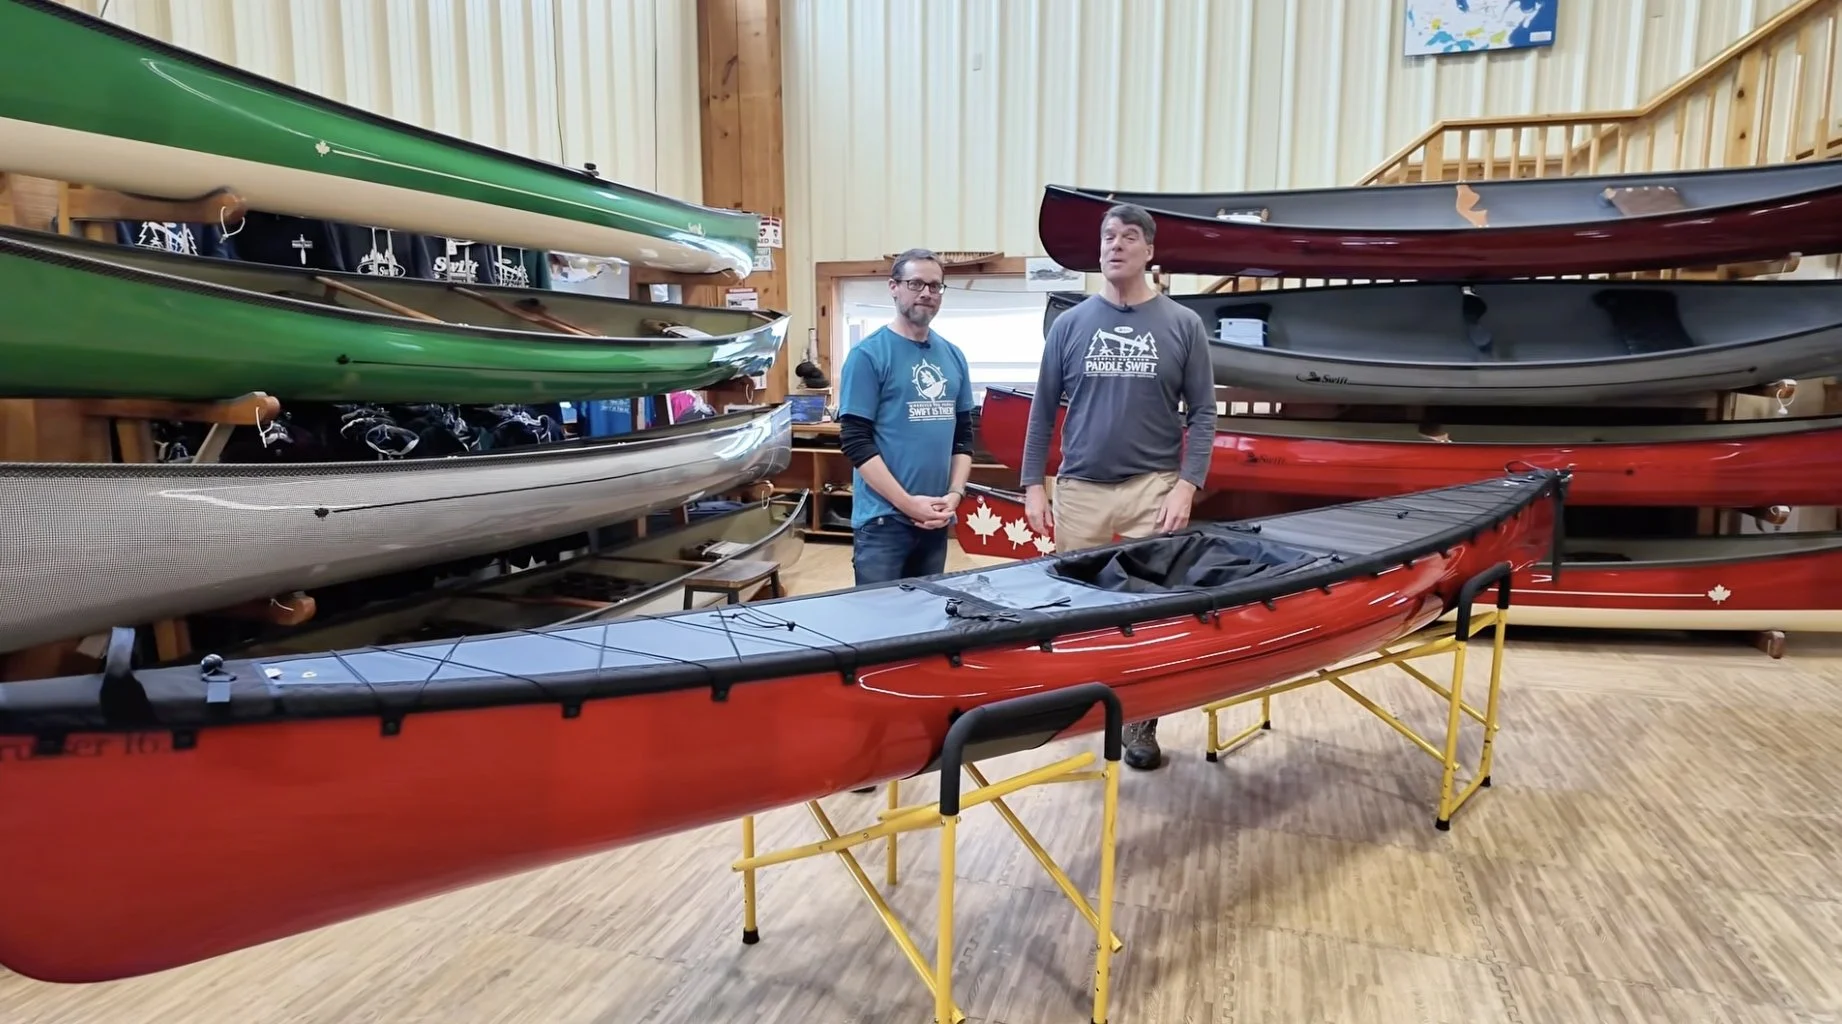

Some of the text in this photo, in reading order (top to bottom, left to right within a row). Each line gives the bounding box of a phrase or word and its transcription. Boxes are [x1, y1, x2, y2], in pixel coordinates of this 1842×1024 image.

[1086, 361, 1157, 373] PADDLE SWIFT
[909, 407, 931, 417] SWIFT
[932, 407, 940, 415] IS
